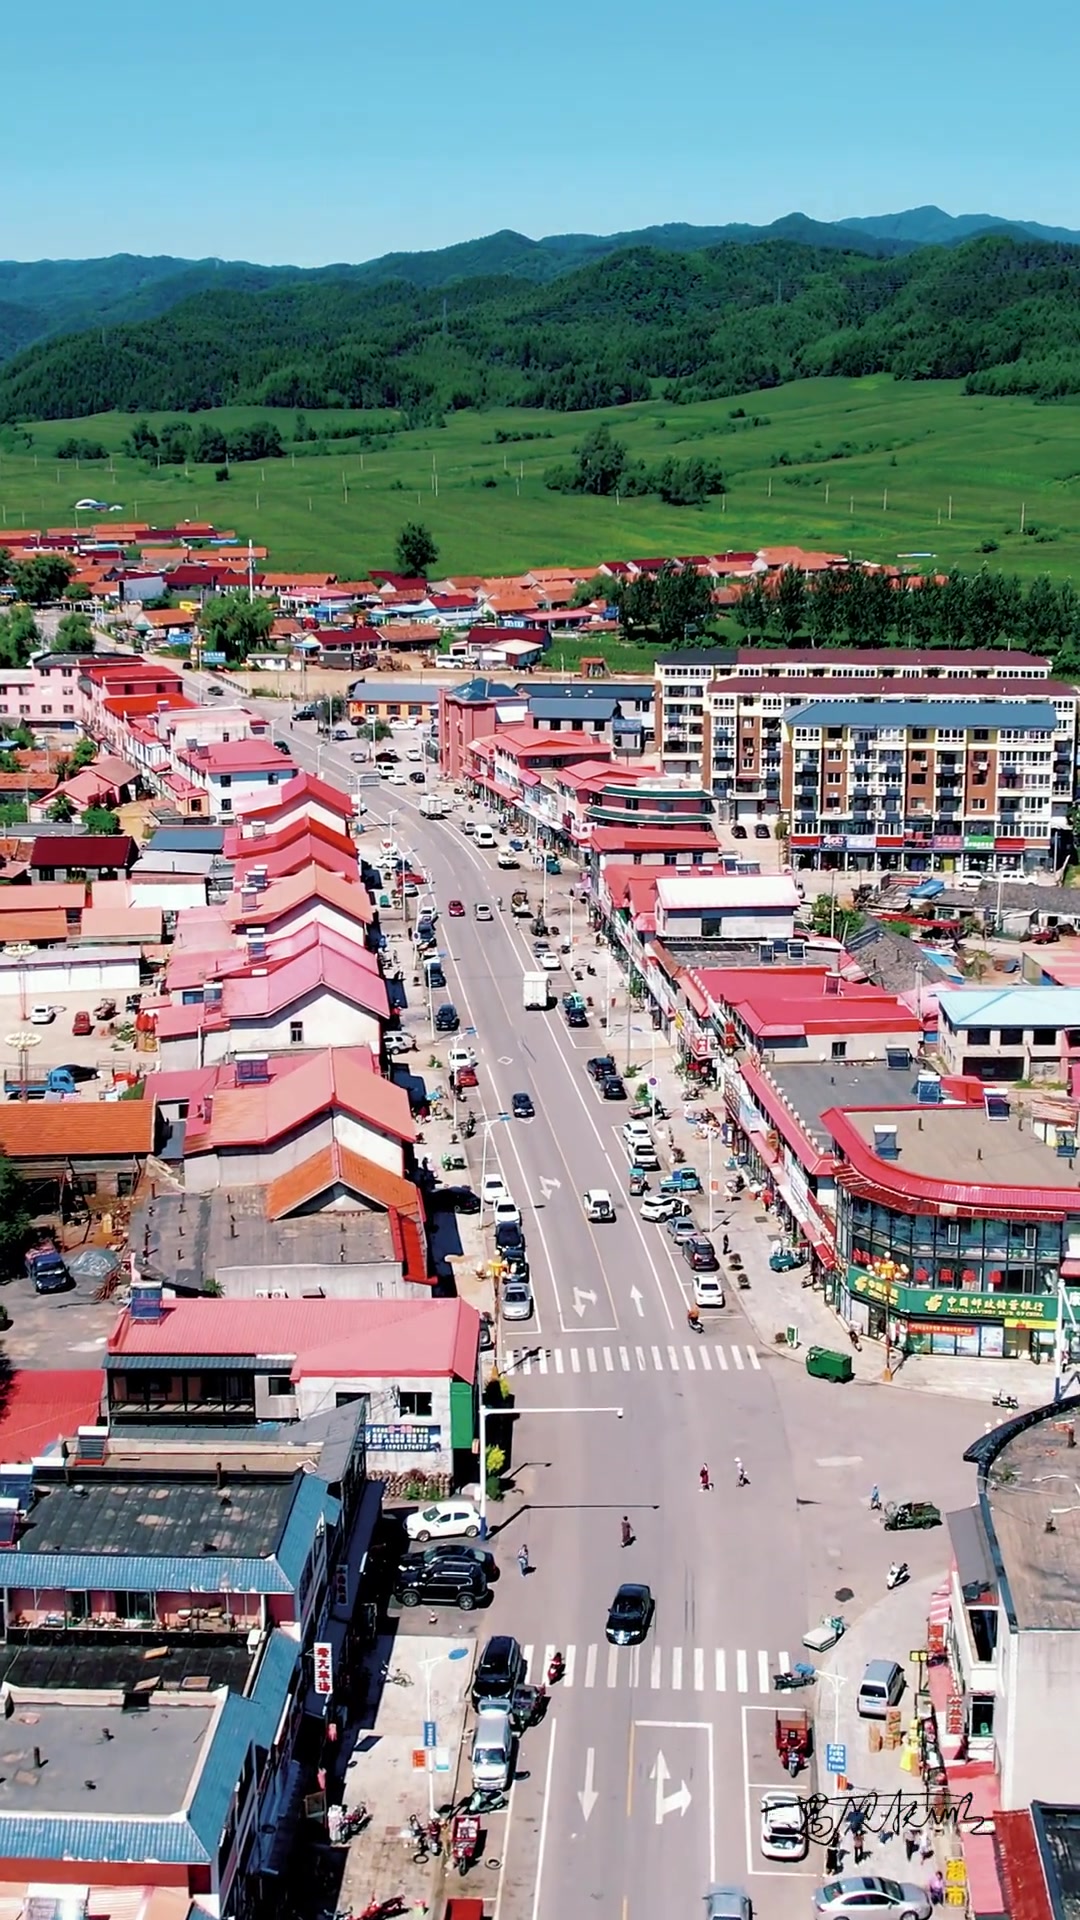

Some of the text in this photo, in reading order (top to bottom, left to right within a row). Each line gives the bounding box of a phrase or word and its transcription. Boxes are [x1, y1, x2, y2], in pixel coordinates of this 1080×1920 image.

[947, 1296, 1044, 1311] 中国邮政储蓄银行
[946, 1859, 966, 1906] 超市
